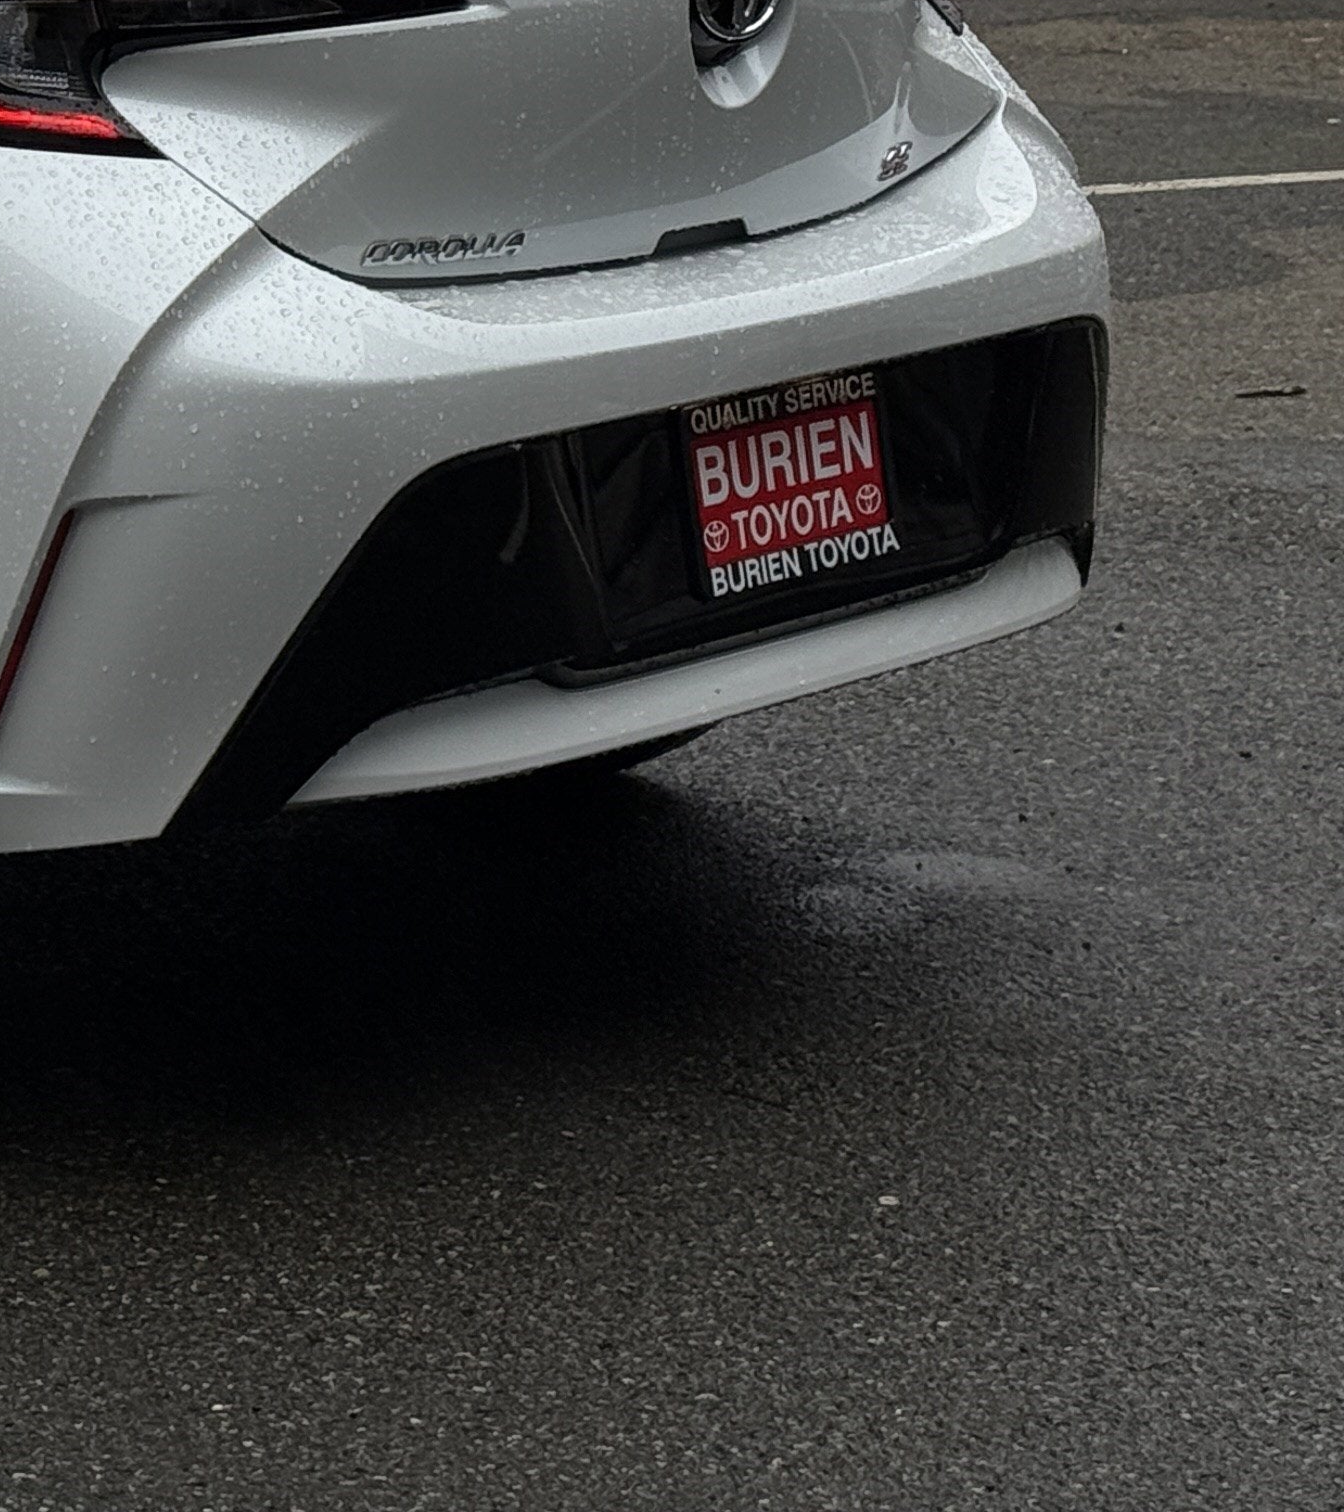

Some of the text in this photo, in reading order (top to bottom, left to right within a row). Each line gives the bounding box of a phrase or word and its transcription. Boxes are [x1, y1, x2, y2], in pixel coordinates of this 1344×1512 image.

[360, 228, 527, 268] COROLLA
[690, 371, 876, 435] QUALITY SERVICE
[696, 410, 874, 508] BURIEN
[730, 486, 854, 551] TOYOTA
[711, 524, 901, 598] BURIEN TOYOTA
